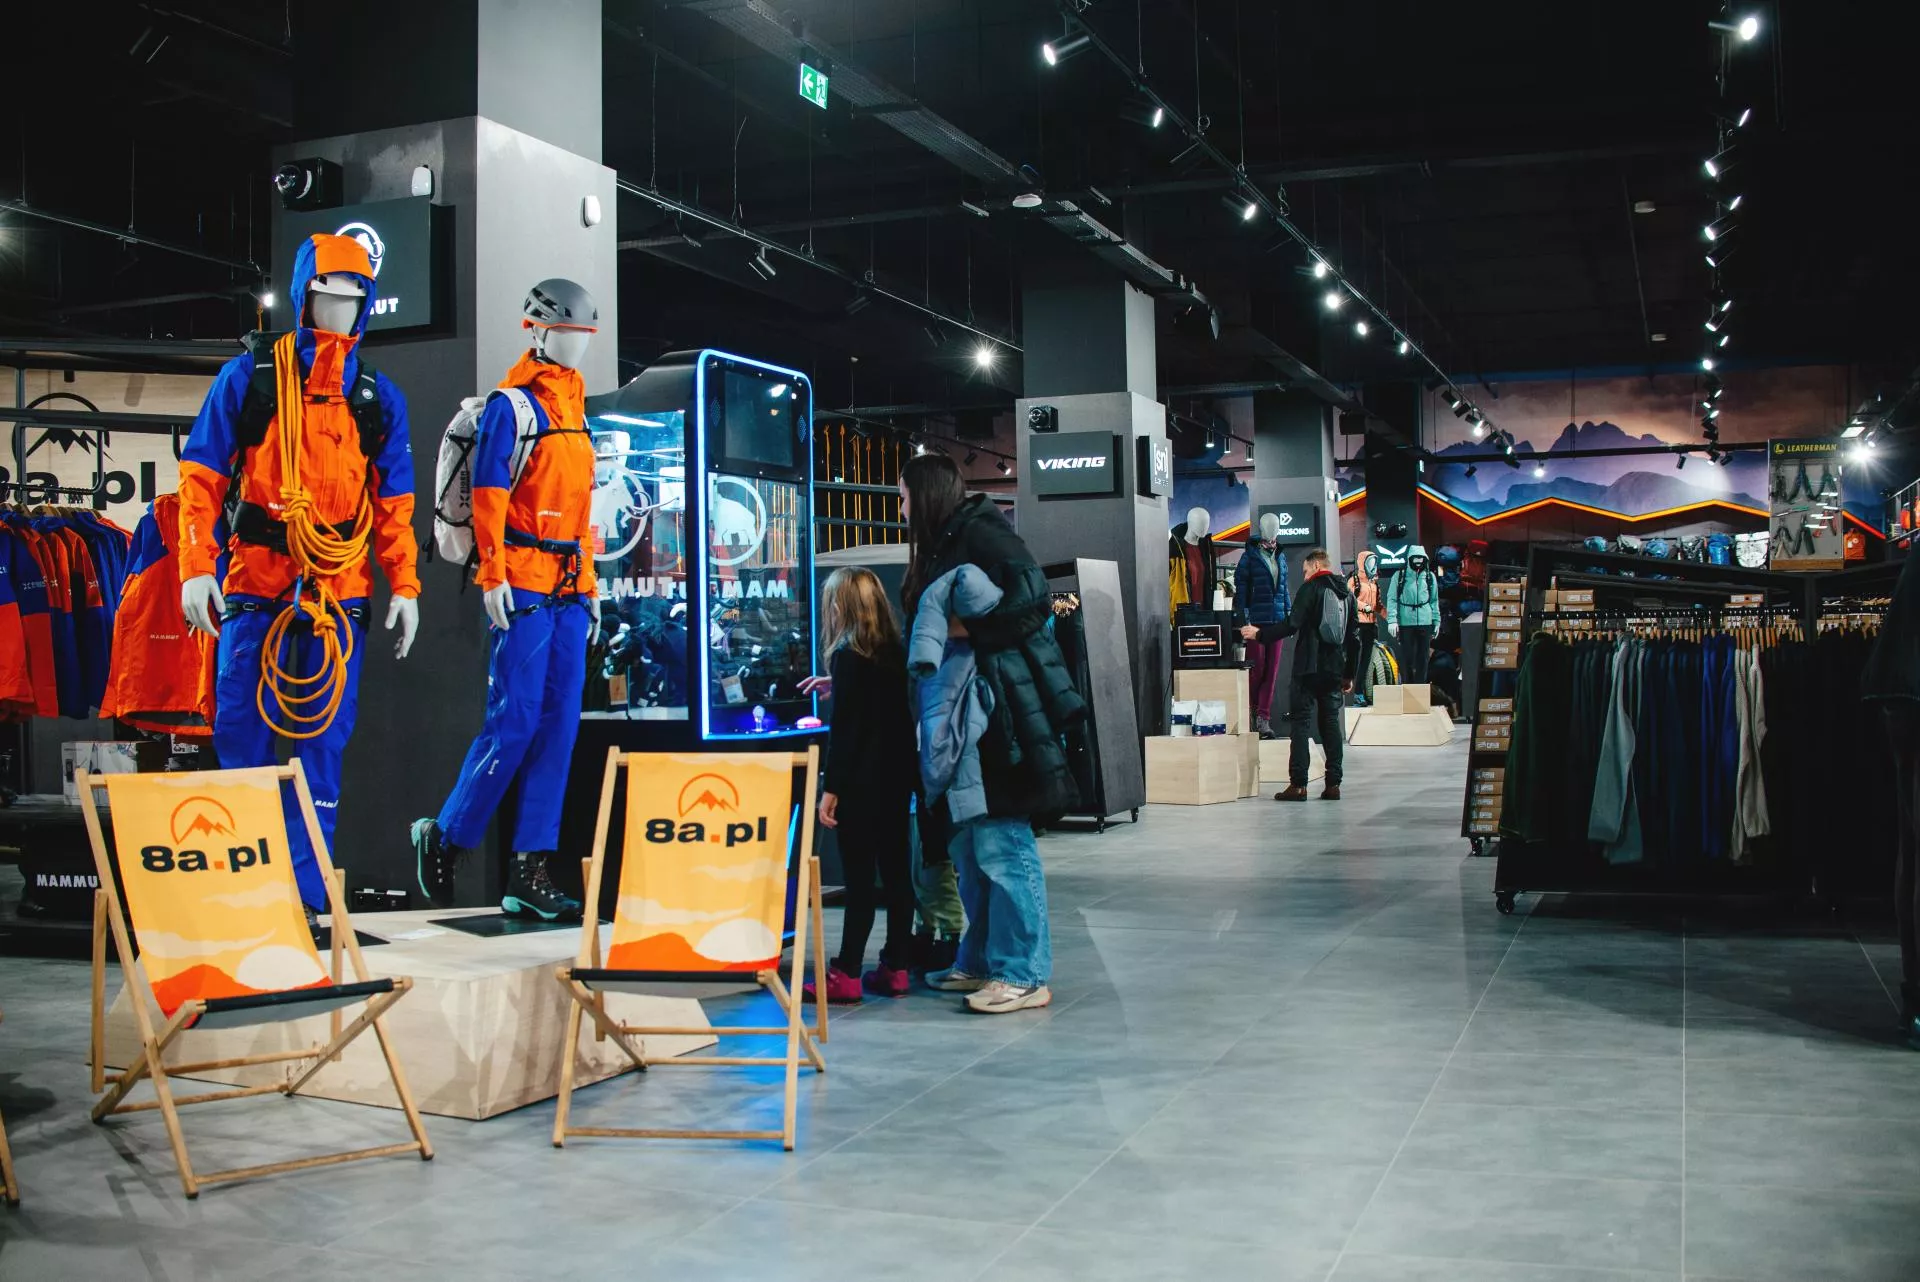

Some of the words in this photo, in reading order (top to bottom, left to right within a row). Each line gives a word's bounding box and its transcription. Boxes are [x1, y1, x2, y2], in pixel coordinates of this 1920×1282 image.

[1787, 443, 1837, 453] LEATHERMAN
[0, 461, 156, 511] a.pl
[1277, 527, 1309, 536] RIKSONS
[646, 816, 768, 848] 8a.pl
[140, 837, 272, 873] 8a.pl
[36, 873, 99, 888] MAMMU
